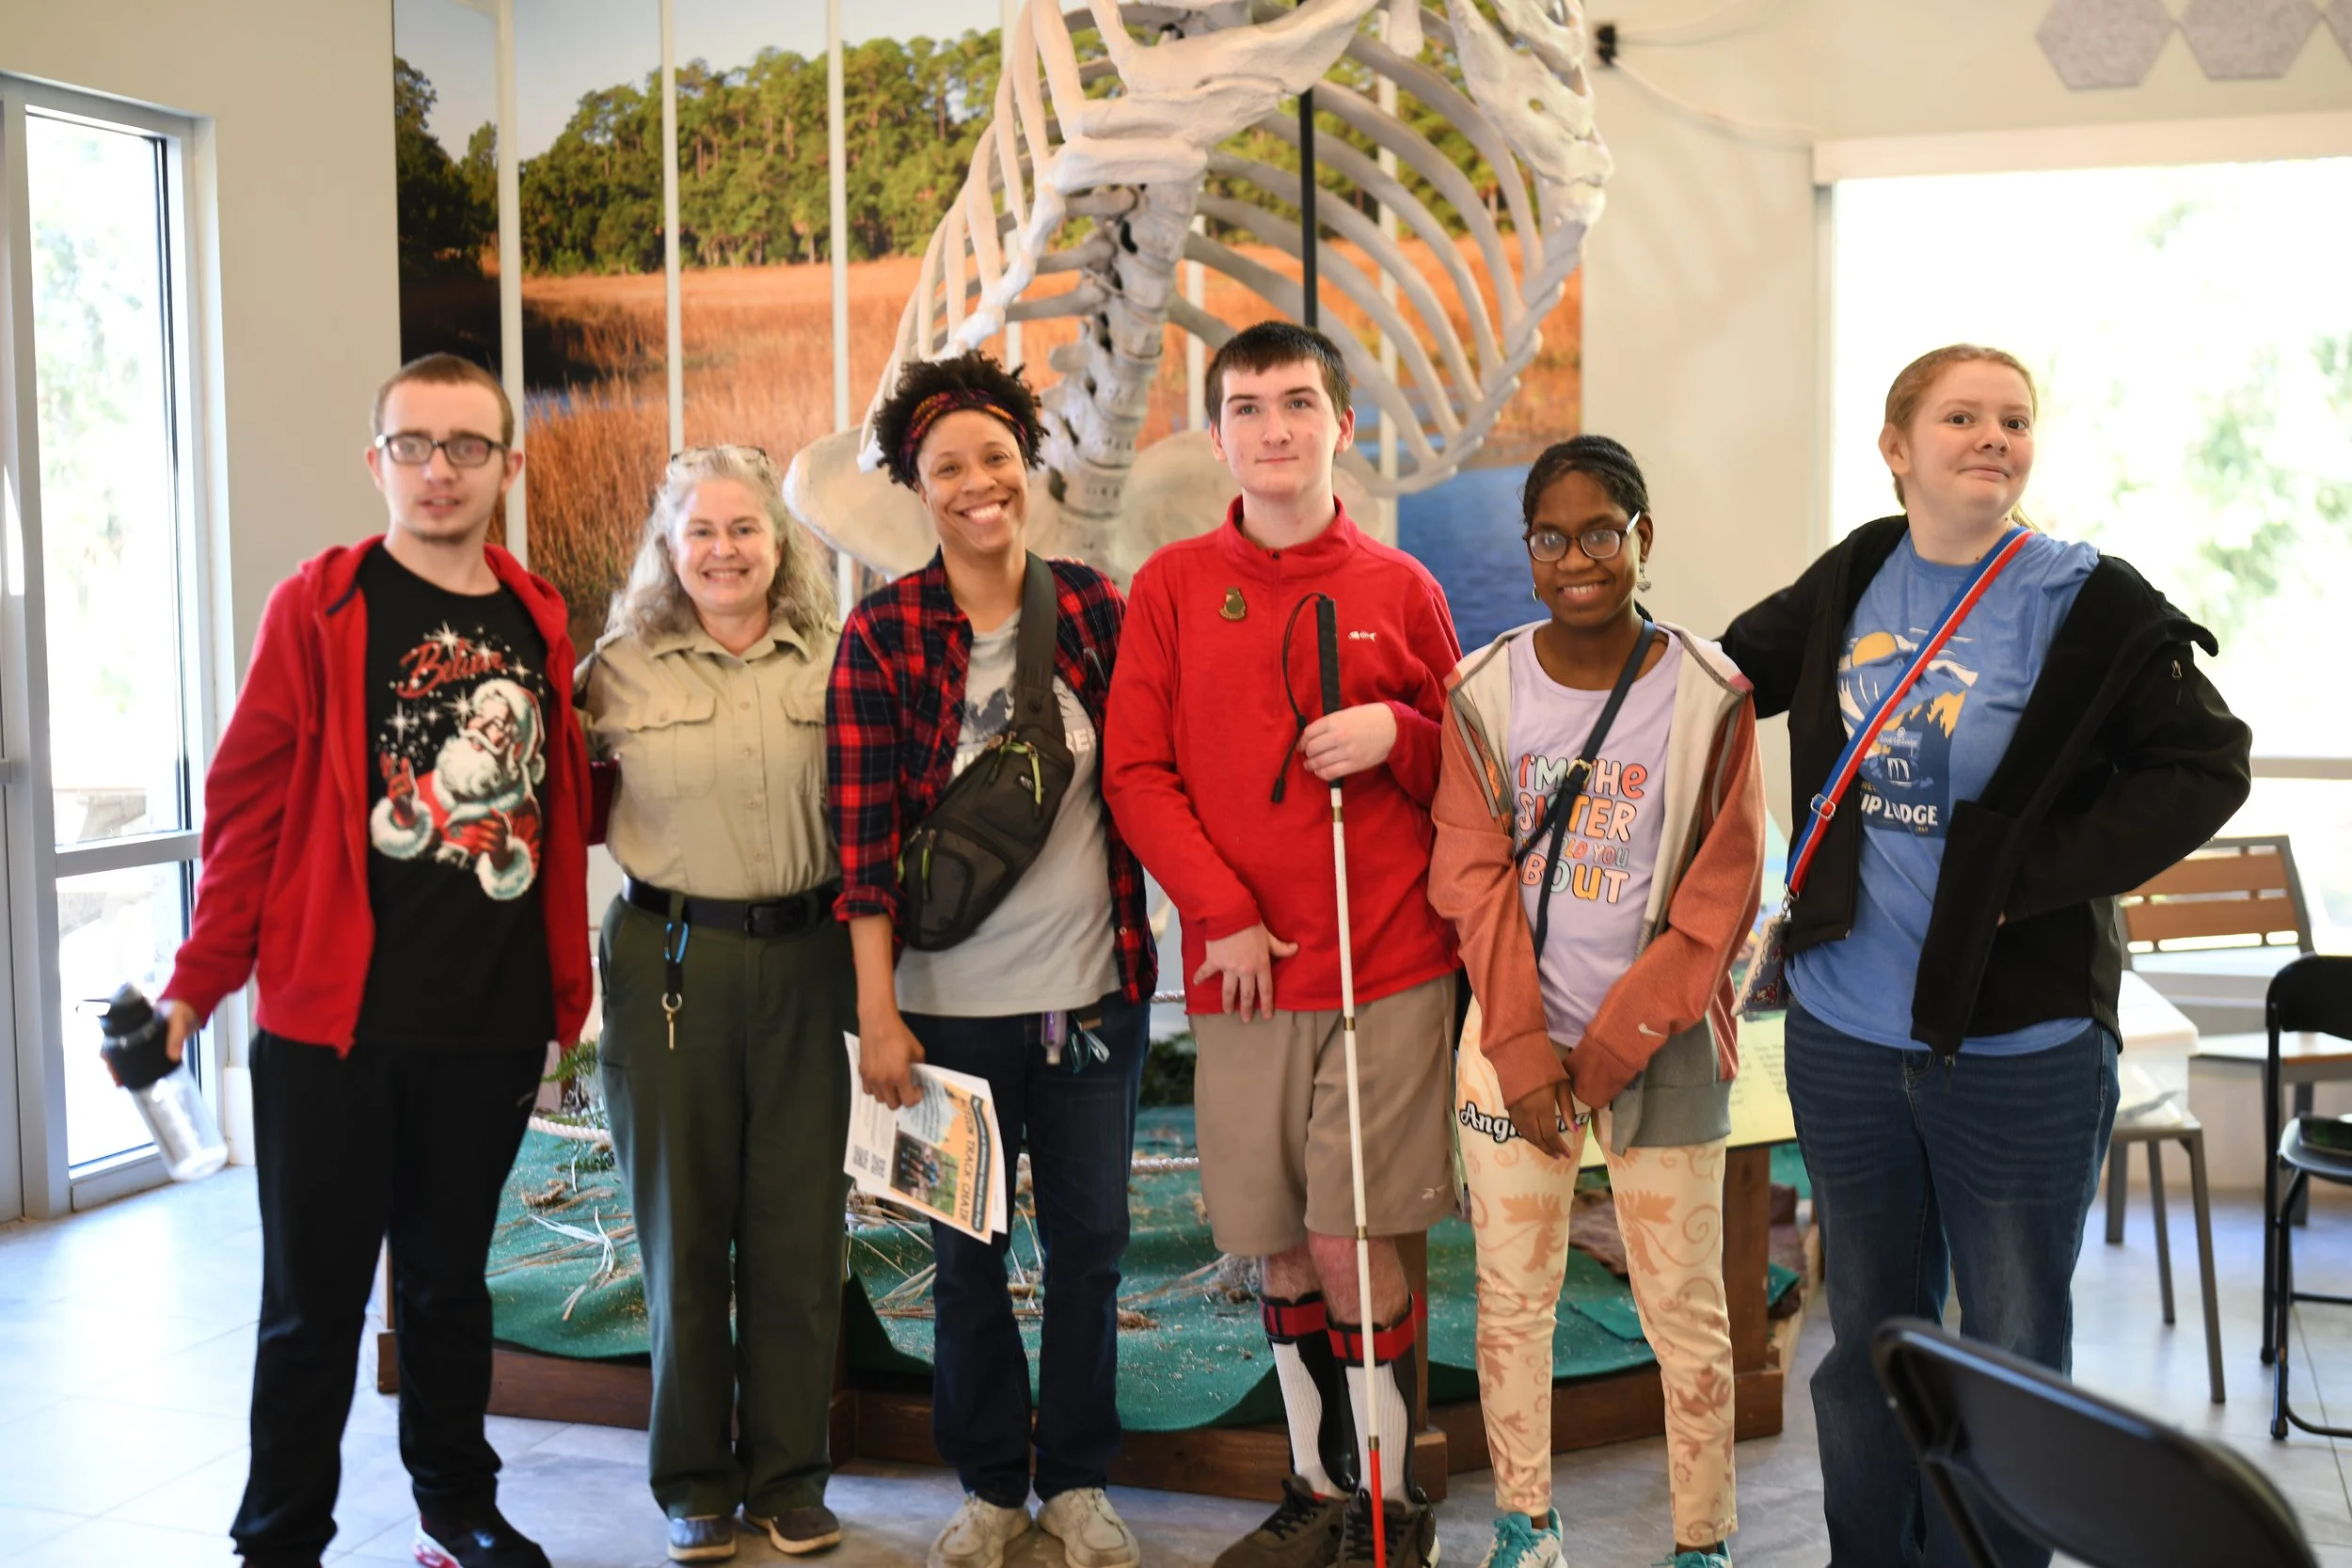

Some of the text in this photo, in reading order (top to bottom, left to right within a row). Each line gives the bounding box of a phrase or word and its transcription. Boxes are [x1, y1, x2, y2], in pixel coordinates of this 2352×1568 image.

[1518, 752, 1568, 791] I'M
[1518, 792, 1637, 843] SITER
[1883, 798, 1938, 826] LODGE
[1593, 842, 1630, 868] YOU
[962, 1140, 977, 1179] TRACK
[959, 1182, 972, 1223] CHAIR
